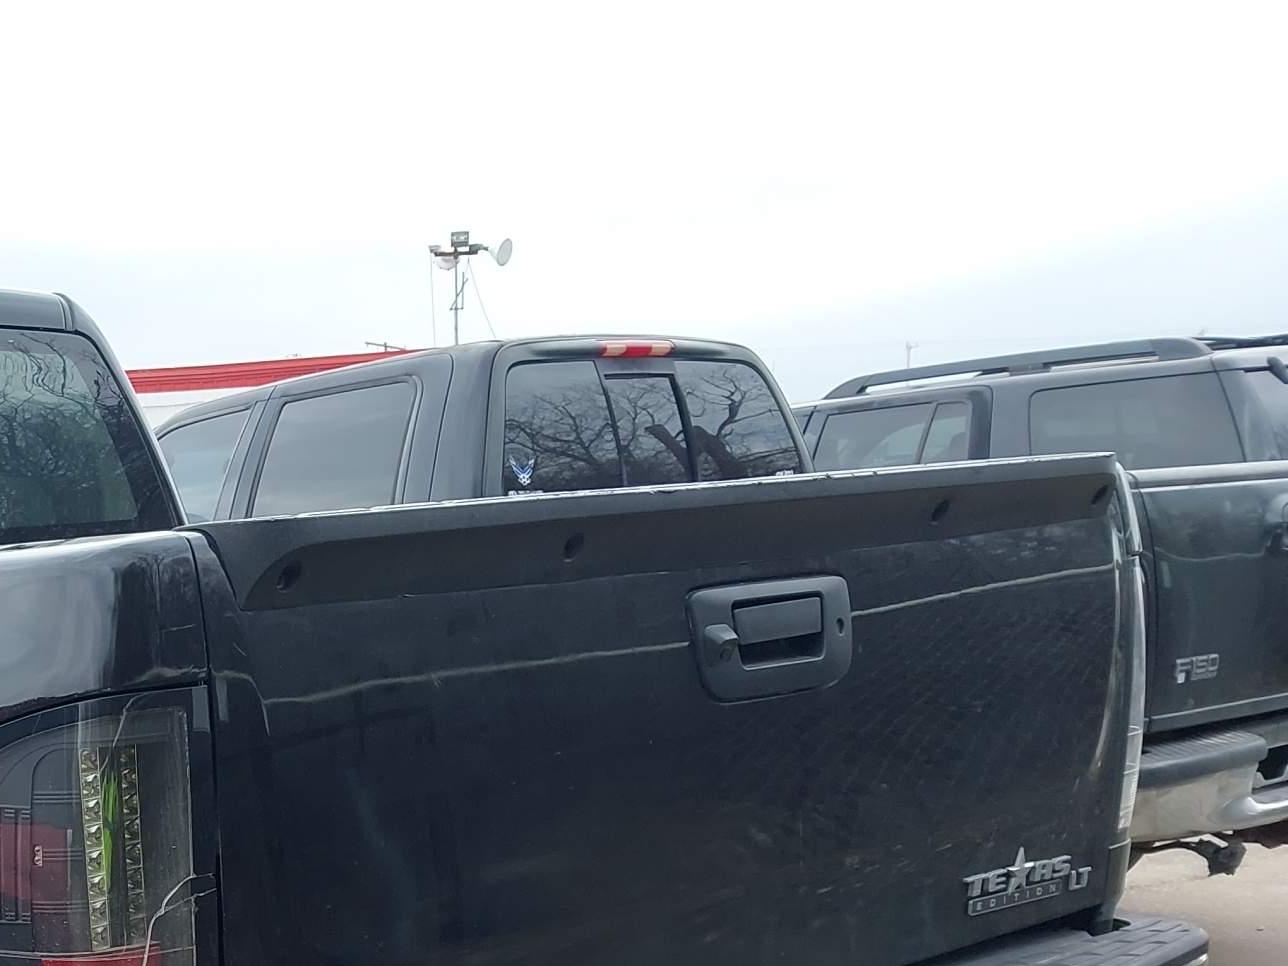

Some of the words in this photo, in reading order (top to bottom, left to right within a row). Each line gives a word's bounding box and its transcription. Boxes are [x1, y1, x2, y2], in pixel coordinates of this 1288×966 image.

[1175, 653, 1220, 684] F150
[1068, 866, 1092, 892] LT
[975, 884, 1058, 912] EDITION
